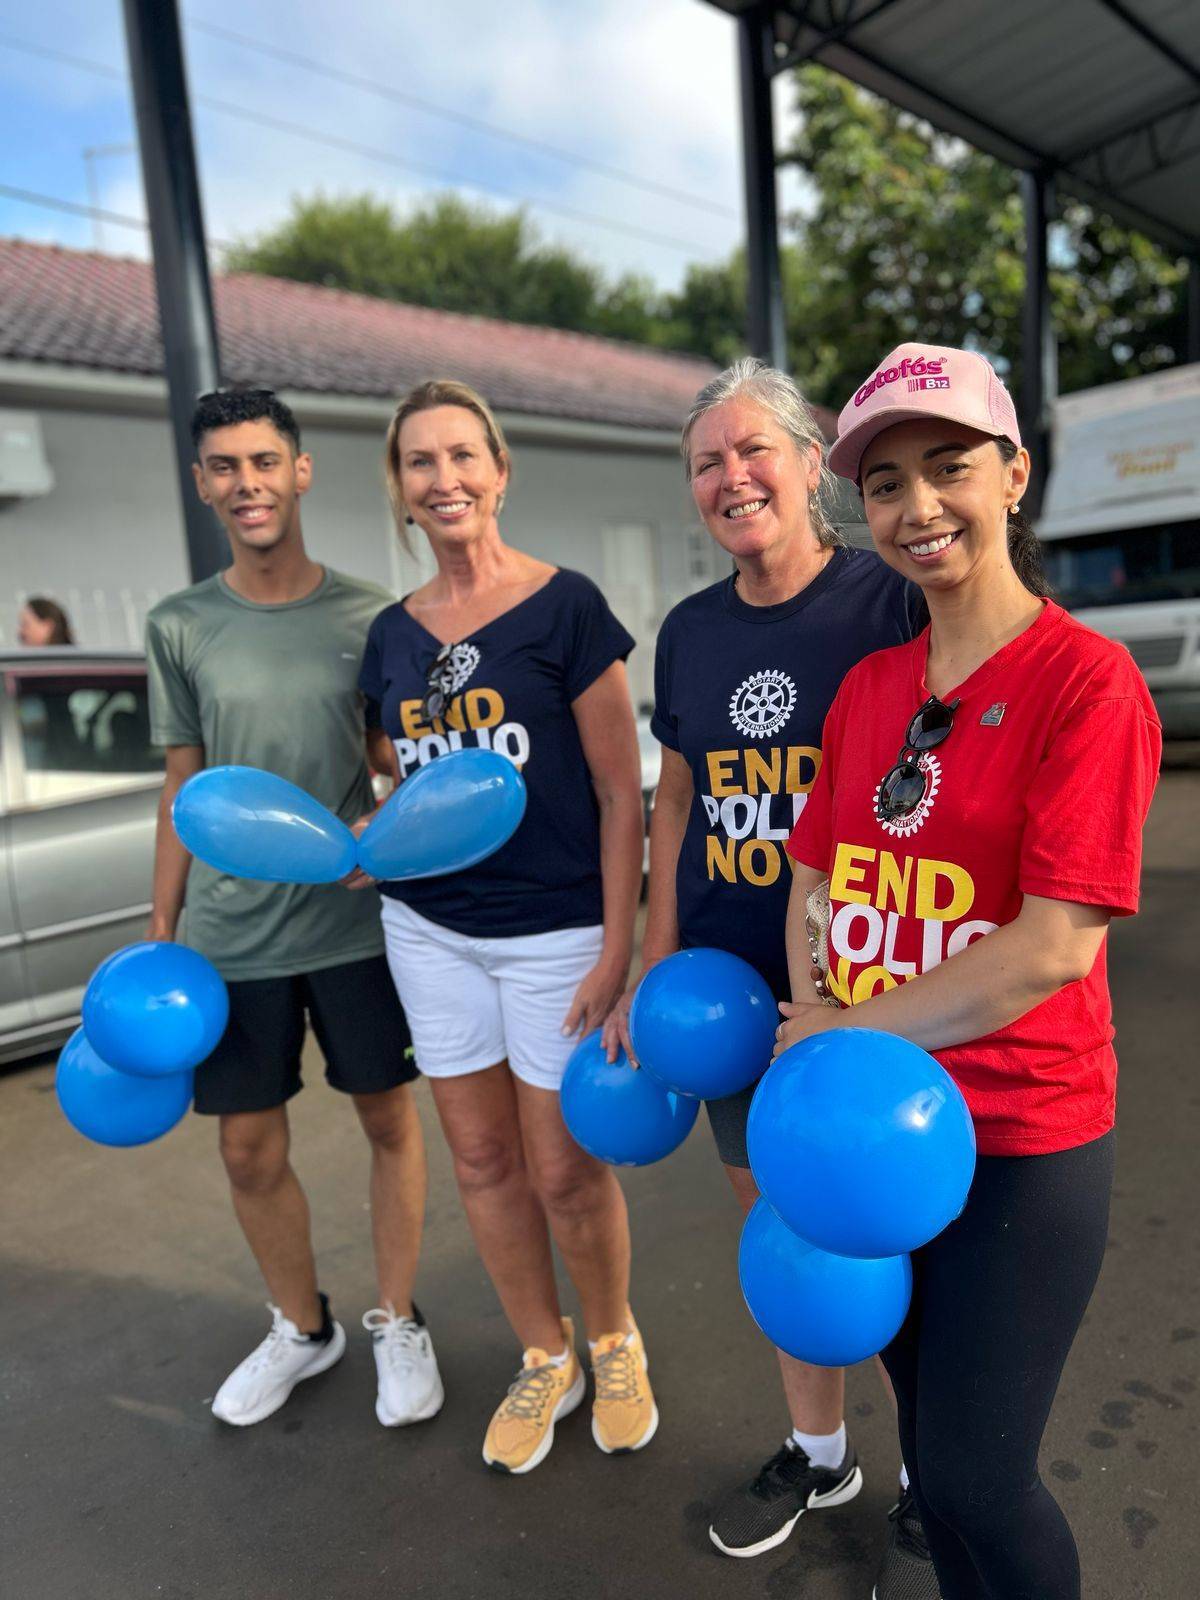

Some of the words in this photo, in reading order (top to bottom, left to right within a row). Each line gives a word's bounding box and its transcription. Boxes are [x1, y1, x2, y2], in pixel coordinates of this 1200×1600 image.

[926, 378, 949, 389] B12
[752, 677, 780, 687] ROTARY
[739, 711, 786, 731] INTERNATIONAL
[706, 746, 822, 797] END
[706, 835, 793, 887] NO
[829, 842, 975, 922] END
